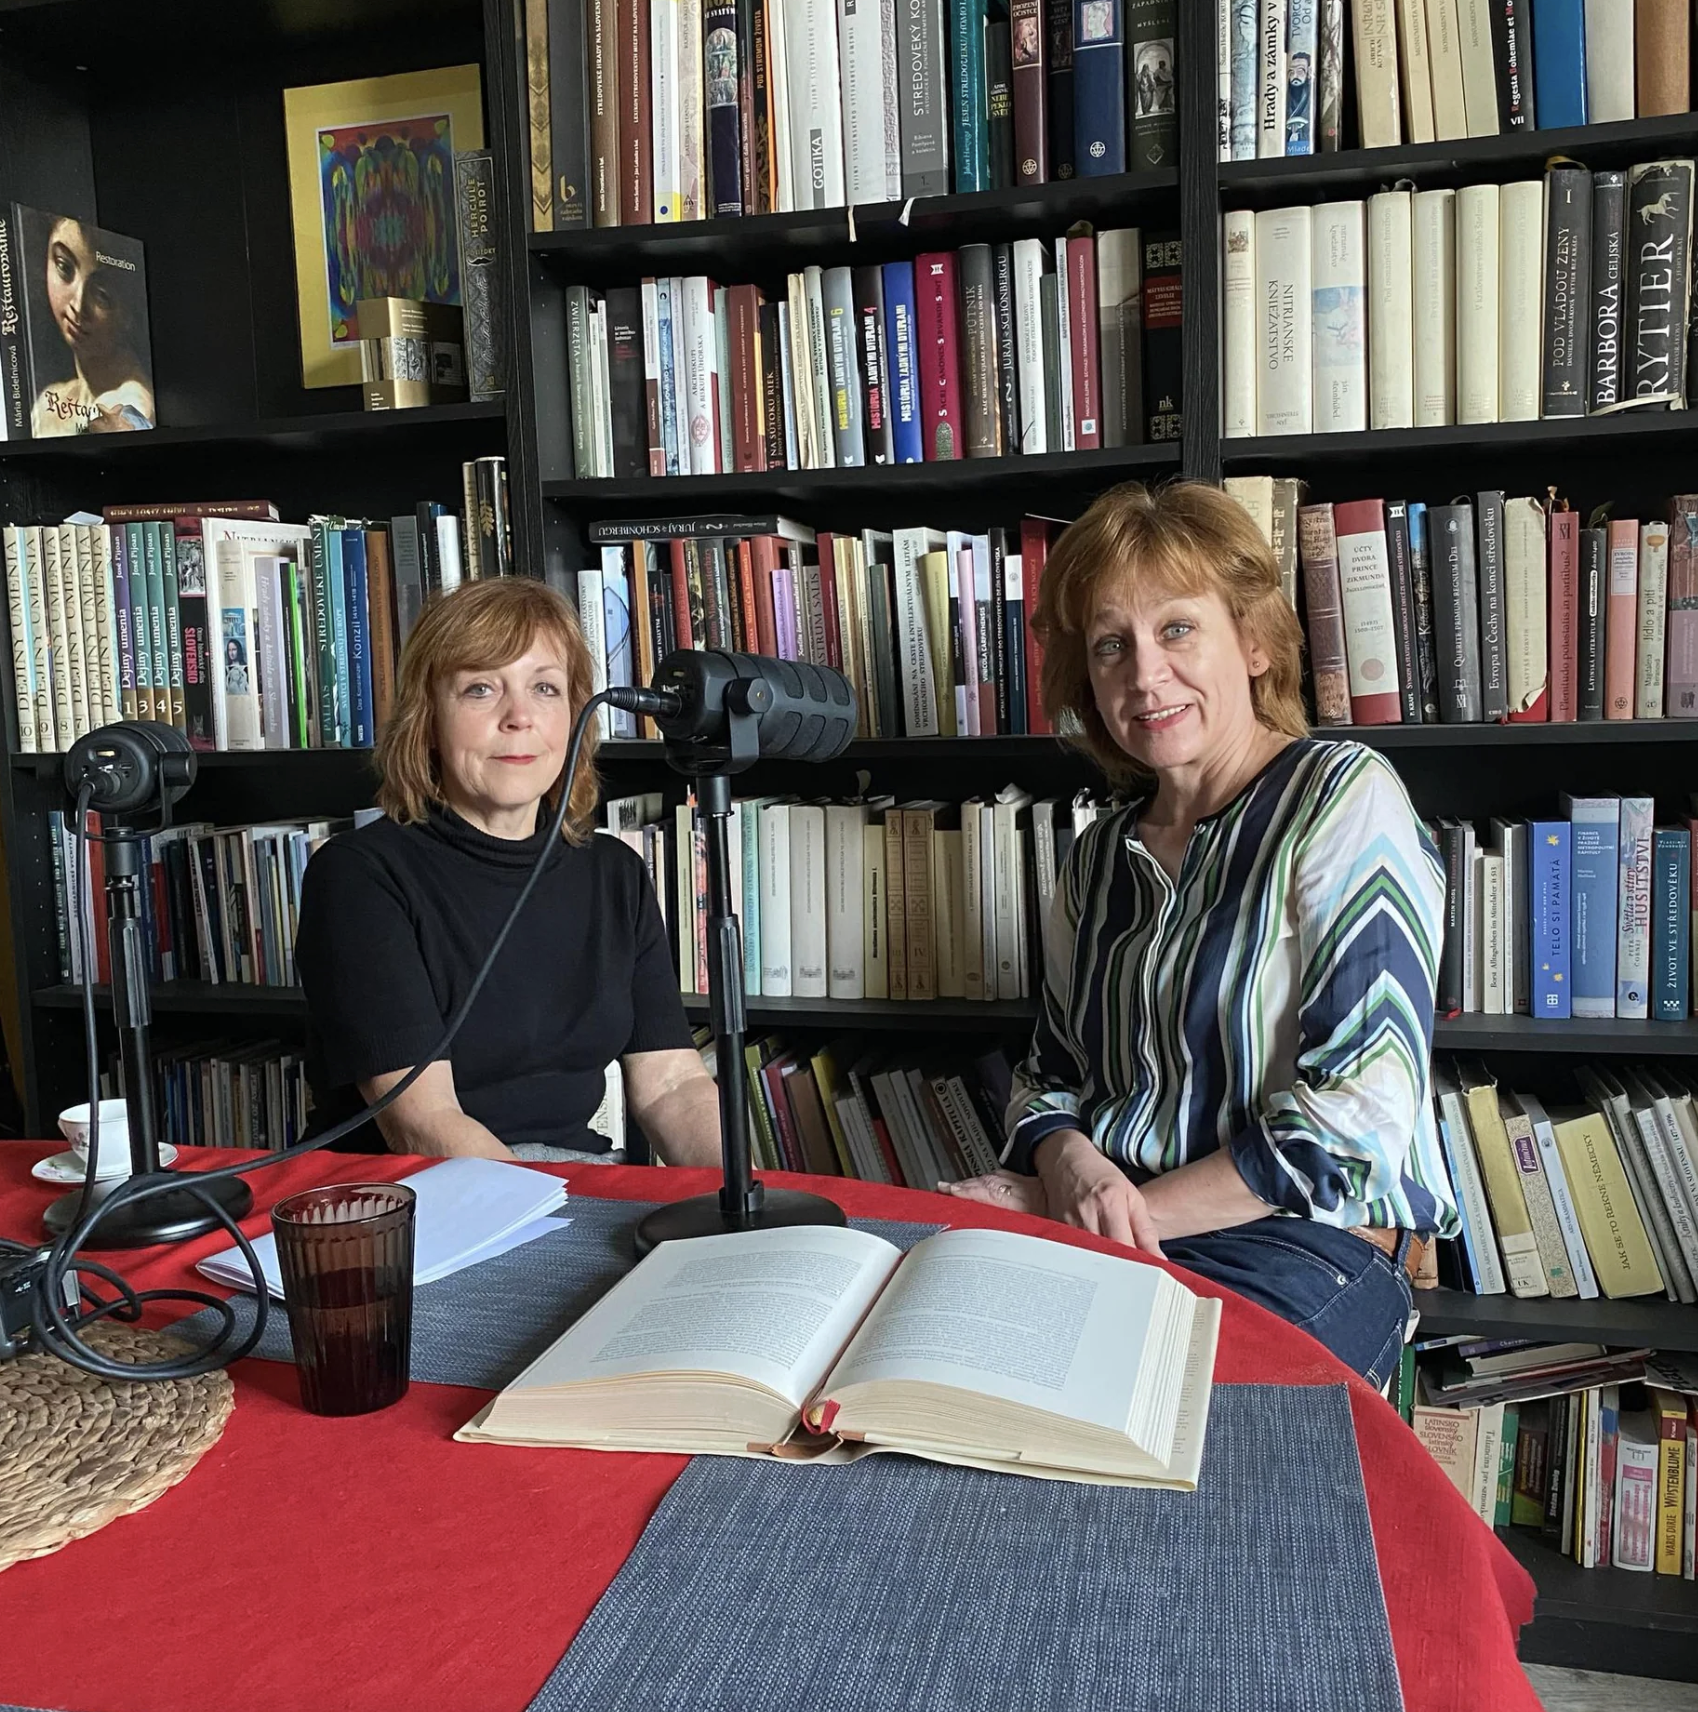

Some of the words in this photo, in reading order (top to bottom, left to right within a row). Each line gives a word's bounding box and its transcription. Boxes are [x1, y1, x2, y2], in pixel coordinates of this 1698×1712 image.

[754, 10, 762, 35] ŽIVOTA
[1268, 2, 1276, 12] v
[1302, 8, 1312, 24] Od
[1507, 17, 1515, 26] et
[595, 32, 602, 43] NA
[1264, 16, 1279, 66] zámky
[909, 24, 924, 116] STREDOVEKÝ
[1267, 71, 1275, 80] a
[1264, 84, 1278, 130] Hrady
[1511, 75, 1520, 111] Regesta
[1510, 116, 1524, 125] VII
[810, 136, 824, 189] GOTIKA
[469, 178, 479, 238] HERCULE
[478, 182, 488, 233] POIROT
[96, 251, 136, 272] Restoration
[1330, 224, 1340, 267] kniežatstvo
[831, 307, 844, 315] 6
[864, 306, 877, 314] 4
[964, 285, 976, 334] PÚTNIK
[1553, 270, 1568, 332] VLÁDOU
[1635, 234, 1674, 397] RYTIER
[571, 301, 581, 357] ZWIERZĘTA
[864, 316, 877, 351] DVERAMI
[895, 305, 907, 341] DVERAMI
[1268, 280, 1280, 370] KNIEŽATSTVO
[1283, 284, 1294, 362] NITRIANSKE
[1596, 283, 1618, 404] BARBORA
[1607, 232, 1620, 280] CELJSKÁ
[831, 317, 843, 352] DVERAMI
[896, 343, 909, 377] ZADNÝMI
[1553, 337, 1565, 367] POD
[766, 372, 774, 395] RIEK
[832, 353, 845, 386] ZADNÝMI
[865, 352, 878, 385] ZADNÝMI
[899, 379, 912, 422] HISTÓRIA
[1159, 396, 1173, 408] nk
[766, 398, 776, 439] SÚTOKU
[769, 442, 777, 456] NA
[667, 522, 695, 533] JURAJ
[1484, 507, 1495, 563] středověku
[114, 536, 122, 561] Pijoan
[130, 533, 138, 558] Pijoan
[146, 533, 155, 558] Pijoan
[163, 534, 172, 558] Pijoan
[903, 539, 911, 567] ELITÁM
[1352, 554, 1376, 563] DVORA
[26, 538, 41, 624] UMENIA
[45, 535, 61, 622] UMENIA
[61, 533, 76, 619] UMENIA
[80, 535, 94, 622] UMENIA
[92, 537, 106, 623] UMENIA
[115, 563, 123, 578] José
[131, 560, 139, 575] José
[148, 560, 156, 575] José
[165, 560, 173, 576] José
[1346, 574, 1385, 583] ZIKMUNDA
[1352, 564, 1377, 572] PRINCE
[1486, 566, 1497, 594] konci
[1561, 551, 1572, 597] partibus?
[6, 541, 22, 628] UMENIA
[1643, 589, 1656, 605] pití
[905, 570, 915, 635] INTELEKTUÁLNYM
[1489, 597, 1496, 609] na
[1560, 600, 1570, 609] in
[118, 609, 128, 649] umenia
[134, 606, 144, 646] umenia
[151, 606, 161, 646] umenia
[168, 607, 178, 647] umenia
[351, 621, 362, 659] Konzil
[1485, 612, 1500, 643] Čechy
[1642, 620, 1654, 641] Jídlo
[68, 629, 82, 704] DEJINY
[185, 627, 197, 683] SLOVENSKO
[917, 627, 926, 674] STREDOVEKU
[13, 637, 30, 711] DEJINY
[33, 634, 48, 708] DEJINY
[53, 633, 68, 706] DEJINY
[86, 631, 102, 707] DEJINY
[100, 633, 113, 708] DEJINY
[121, 652, 133, 688] Dejiny
[136, 650, 149, 686] Dejiny
[153, 650, 165, 686] Dejiny
[170, 651, 182, 687] Dejiny
[912, 669, 918, 679] NA
[1488, 654, 1500, 689] Evropa
[1644, 654, 1653, 686] Magdalena
[1653, 659, 1661, 686] Beranová
[920, 678, 929, 727] VRCHOLNÉHO
[1559, 662, 1570, 711] Plenitudo
[124, 702, 133, 714] 1
[139, 701, 149, 714] 3
[156, 700, 166, 713] 4
[174, 702, 182, 714] 5
[912, 683, 921, 728] DOMINIKÁNI
[1624, 867, 1636, 893] stíny
[1490, 886, 1498, 919] Mittelalter
[1666, 863, 1678, 934] STŘEDOVĚKU
[1490, 920, 1498, 929] im
[1551, 912, 1560, 922] SI
[1621, 903, 1634, 933] Světla
[1489, 930, 1498, 969] Alltagsleben
[1551, 928, 1560, 956] TELO
[1668, 939, 1677, 951] VE
[1490, 972, 1498, 988] Borst
[1665, 957, 1677, 988] ŽIVOT
[1610, 1221, 1620, 1235] TO
[1614, 1236, 1624, 1248] SE
[1618, 1251, 1631, 1270] JAK
[1420, 1432, 1463, 1442] SLOVENSKO
[1425, 1418, 1459, 1428] LATINSKO
[1425, 1425, 1458, 1434] slovenský
[1482, 1430, 1495, 1468] Taliančina
[1482, 1471, 1490, 1484] pre
[1664, 1447, 1680, 1508] WÜSTENBLUME
[1549, 1493, 1558, 1517] Stefan
[1666, 1514, 1677, 1534] DIRIE
[1665, 1535, 1676, 1557] WARIS
